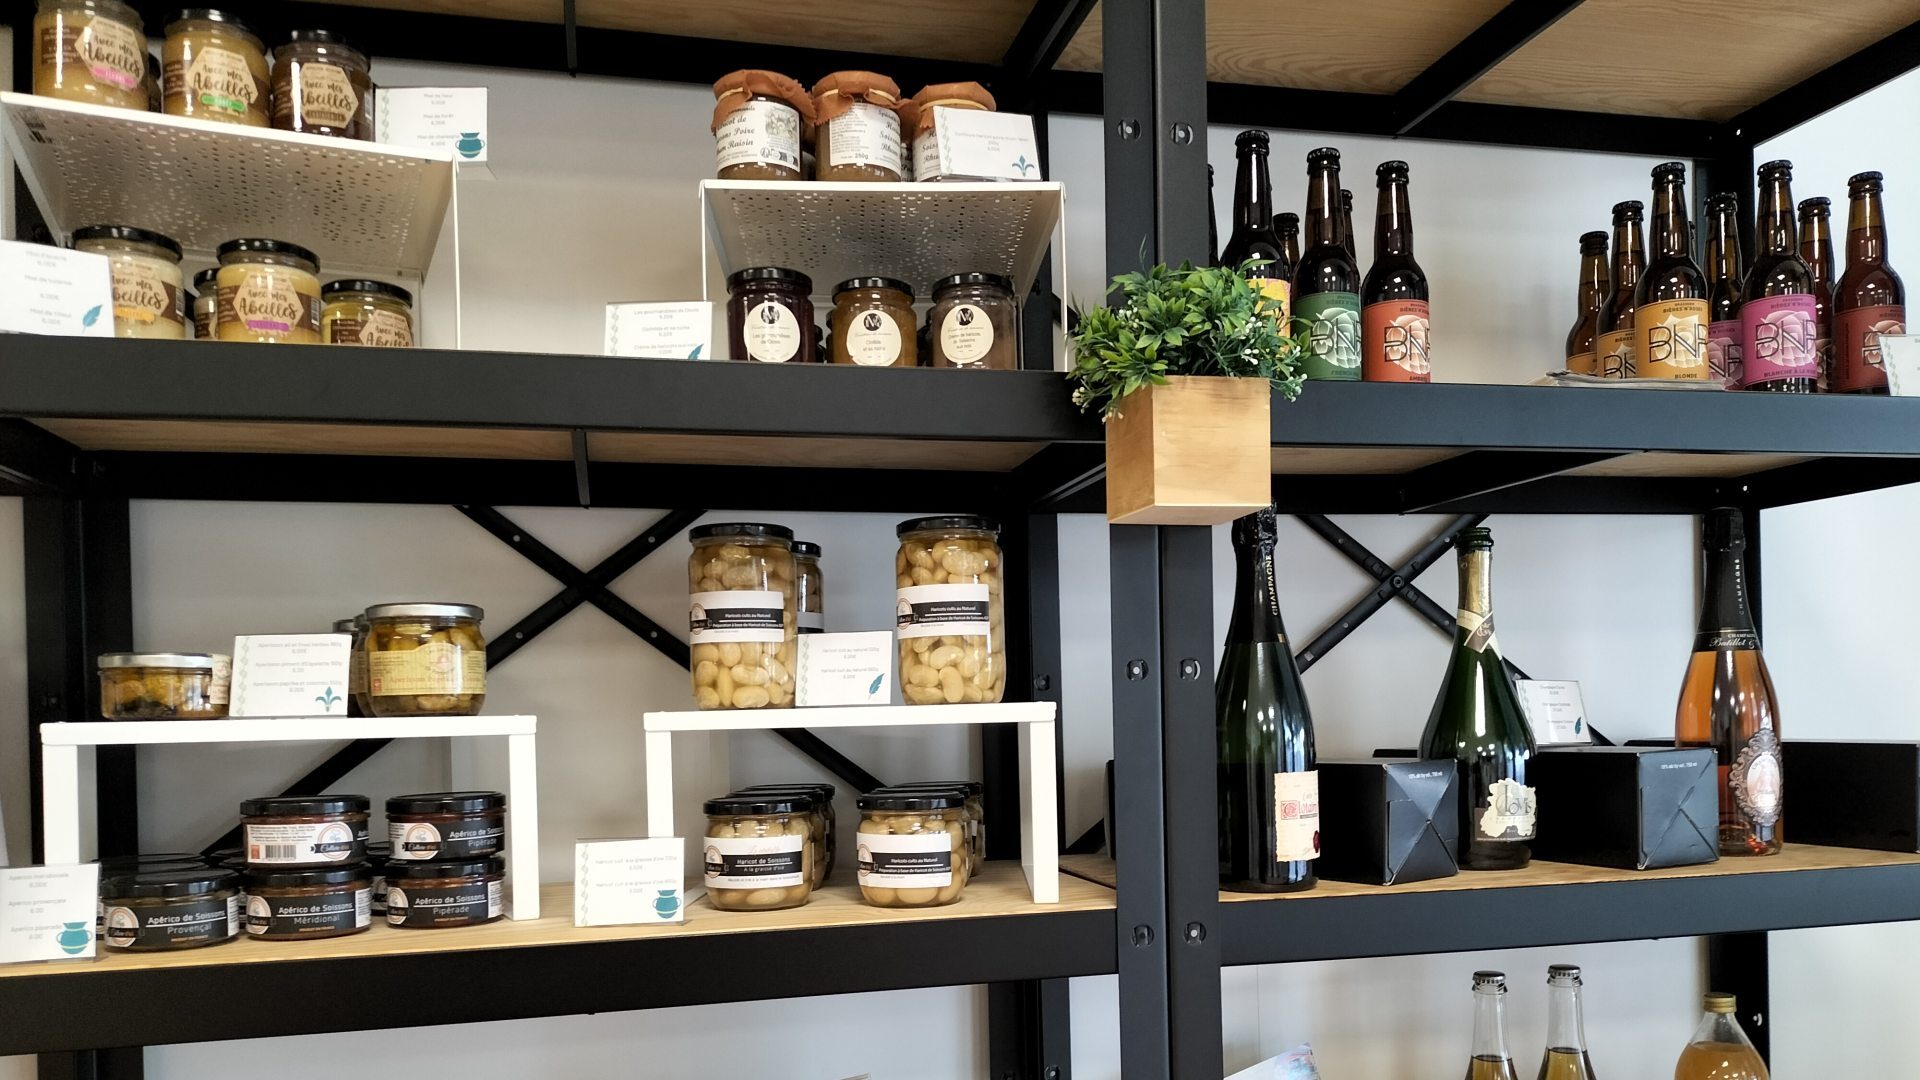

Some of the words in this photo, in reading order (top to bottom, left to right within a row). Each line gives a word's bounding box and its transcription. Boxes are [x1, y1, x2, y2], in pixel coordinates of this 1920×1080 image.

[193, 72, 252, 101] Abeilles
[112, 287, 164, 310] beilles
[239, 297, 298, 320] Abeilles
[1662, 306, 1682, 314] BIÈRES
[1763, 369, 1793, 378] BLANCHE
[1265, 554, 1279, 616] CHAMPAGNE
[1734, 559, 1745, 616] CHAMPAGNE
[449, 830, 477, 838] Apérico
[415, 897, 443, 905] Apérico
[444, 896, 454, 904] de
[455, 894, 485, 903] Soissons
[278, 906, 308, 915] Apérico
[310, 905, 321, 913] de
[322, 902, 353, 911] Soissons
[432, 906, 470, 916] Pipérade
[147, 916, 181, 925] Apérico
[182, 914, 193, 922] de
[195, 910, 226, 920] Soissons
[293, 915, 340, 925] Méridional
[167, 923, 212, 935] Provençal
